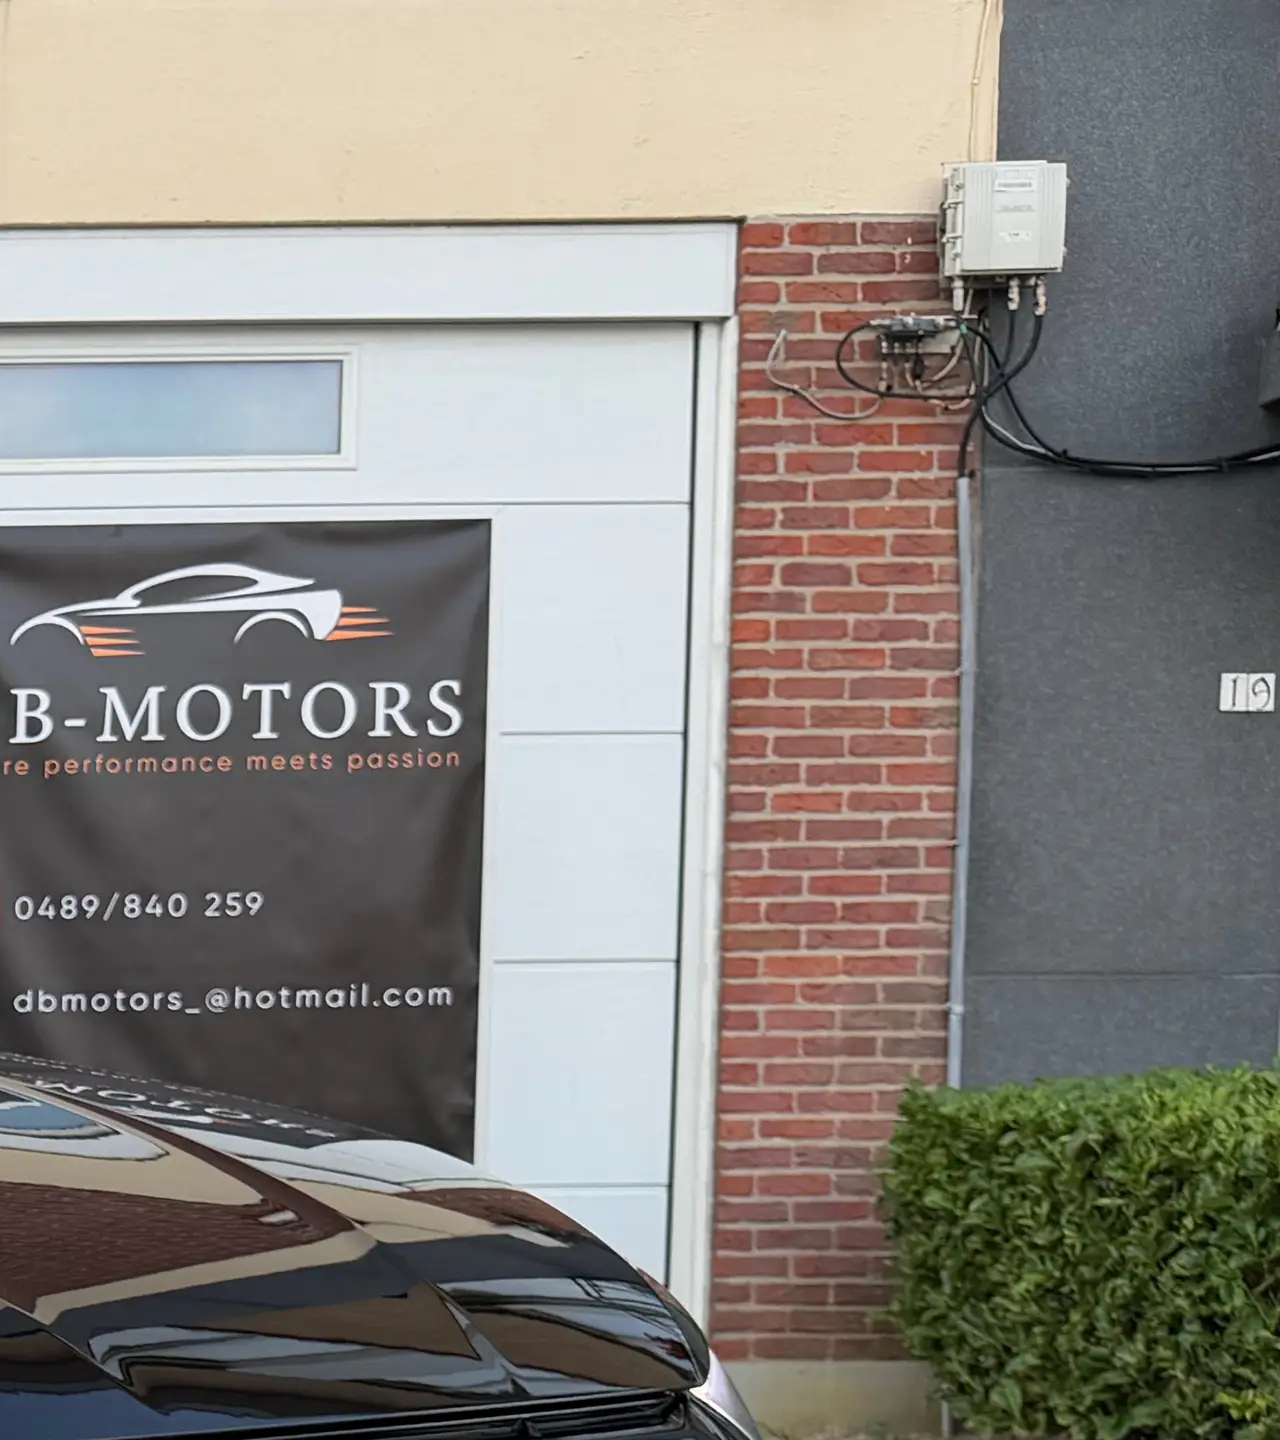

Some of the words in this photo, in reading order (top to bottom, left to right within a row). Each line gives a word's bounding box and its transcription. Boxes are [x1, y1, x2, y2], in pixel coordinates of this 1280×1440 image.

[1231, 676, 1271, 712] 19
[43, 752, 233, 780] performance
[246, 751, 333, 772] meets
[347, 747, 460, 774] passion
[13, 891, 188, 922] 0489/840
[203, 890, 265, 919] 259
[13, 982, 454, 1015] dbmotors_@hotmail.com
